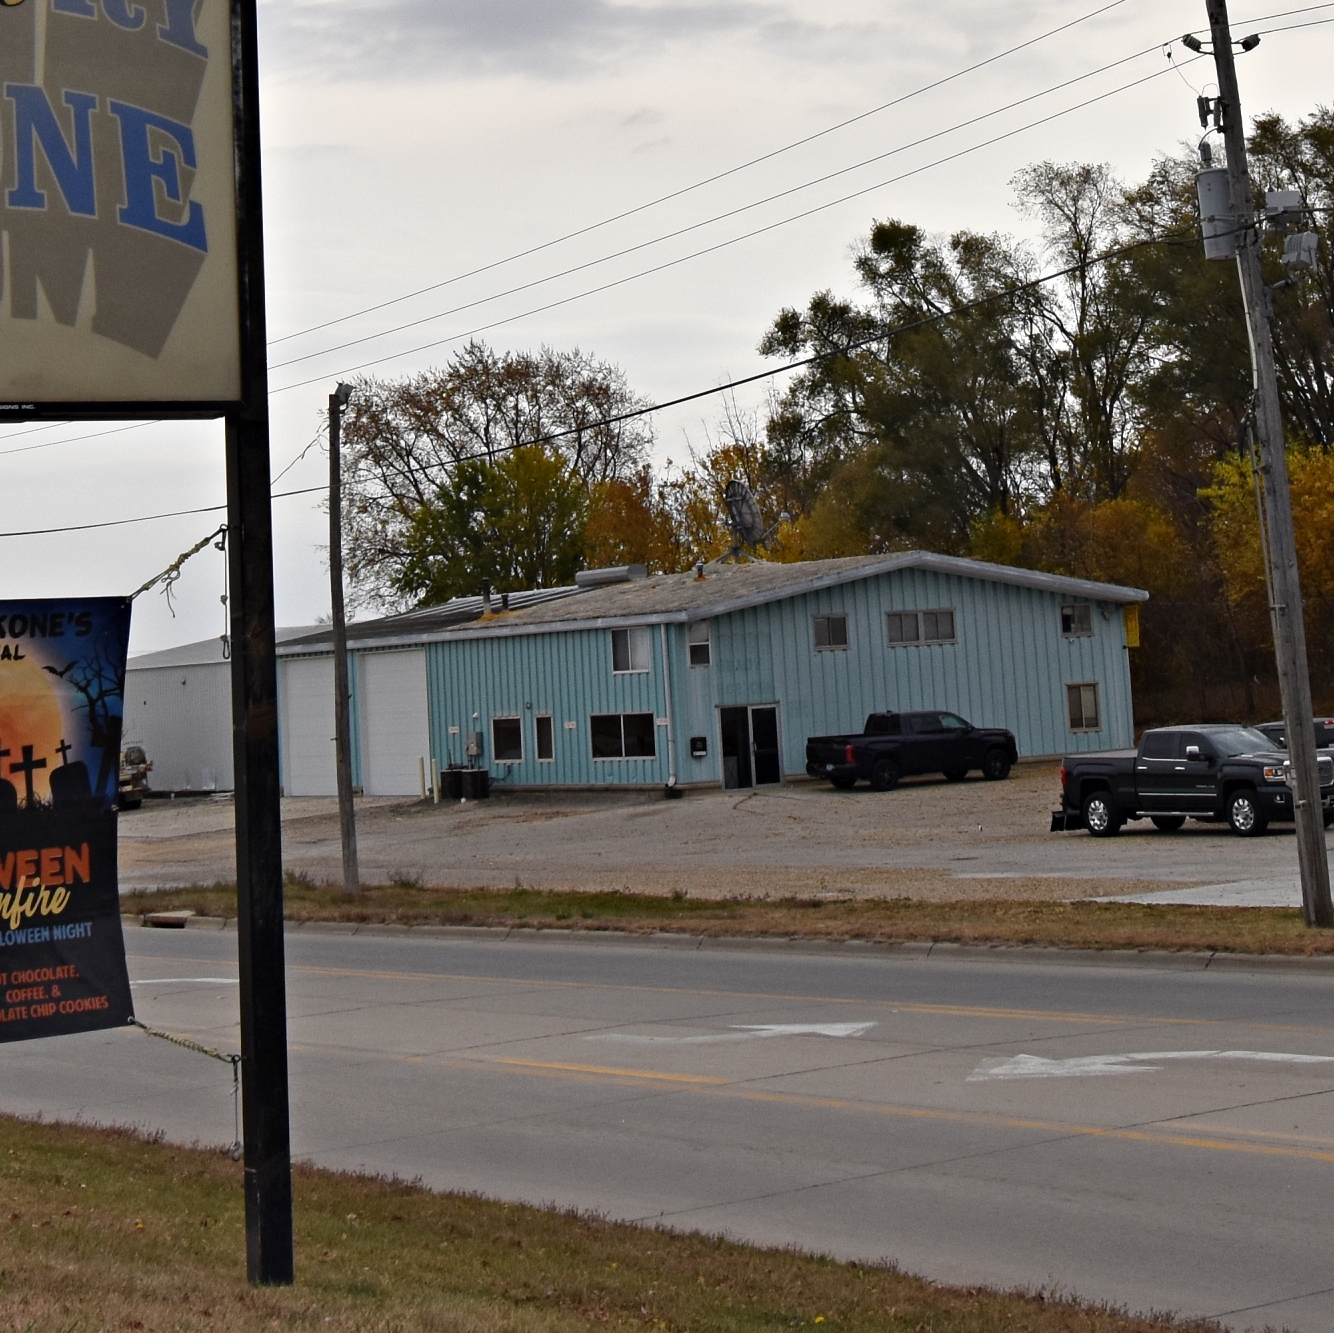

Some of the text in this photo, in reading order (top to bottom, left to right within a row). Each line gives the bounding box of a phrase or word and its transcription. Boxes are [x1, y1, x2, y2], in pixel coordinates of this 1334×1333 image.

[53, 922, 93, 940] NIGHT
[51, 984, 61, 997] &
[30, 1003, 56, 1017] CHIP
[59, 996, 109, 1015] COOKIES
